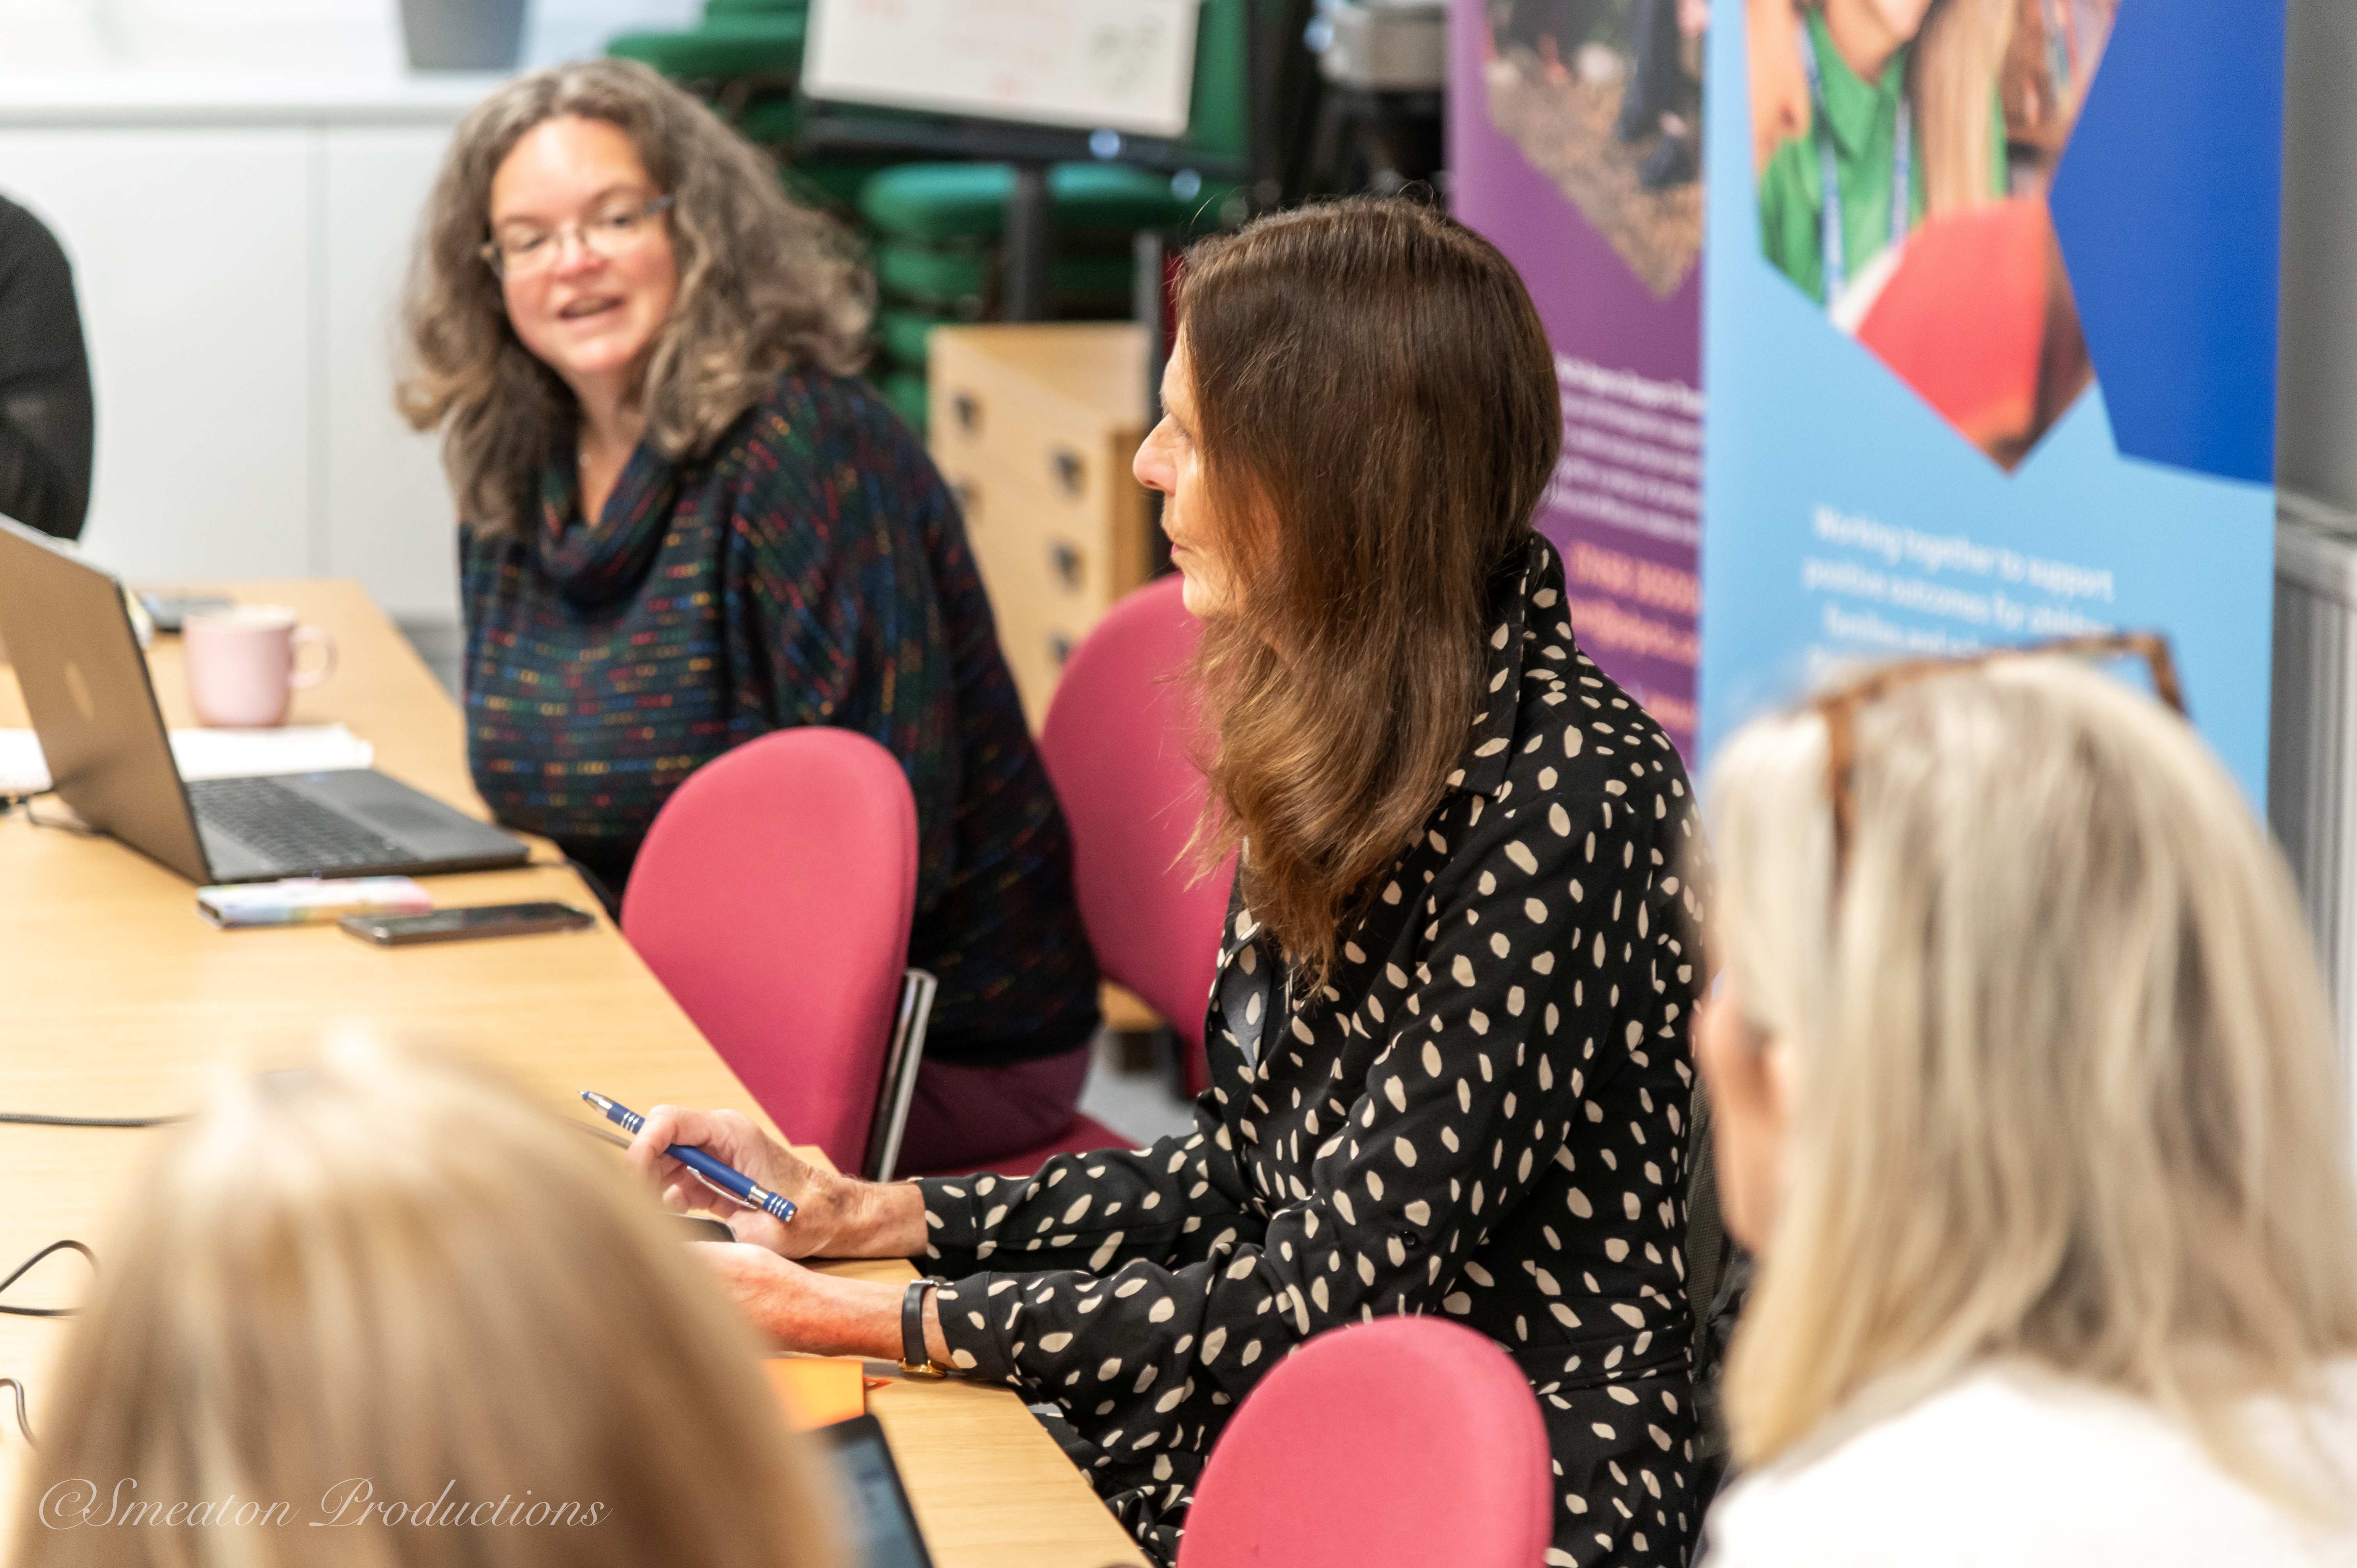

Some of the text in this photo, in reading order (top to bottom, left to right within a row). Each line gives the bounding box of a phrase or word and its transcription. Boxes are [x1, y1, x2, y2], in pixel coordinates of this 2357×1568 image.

[1905, 530, 1994, 575] together
[2000, 547, 2025, 582] to
[1891, 577, 1990, 623] outcomes
[1993, 591, 2025, 629] for
